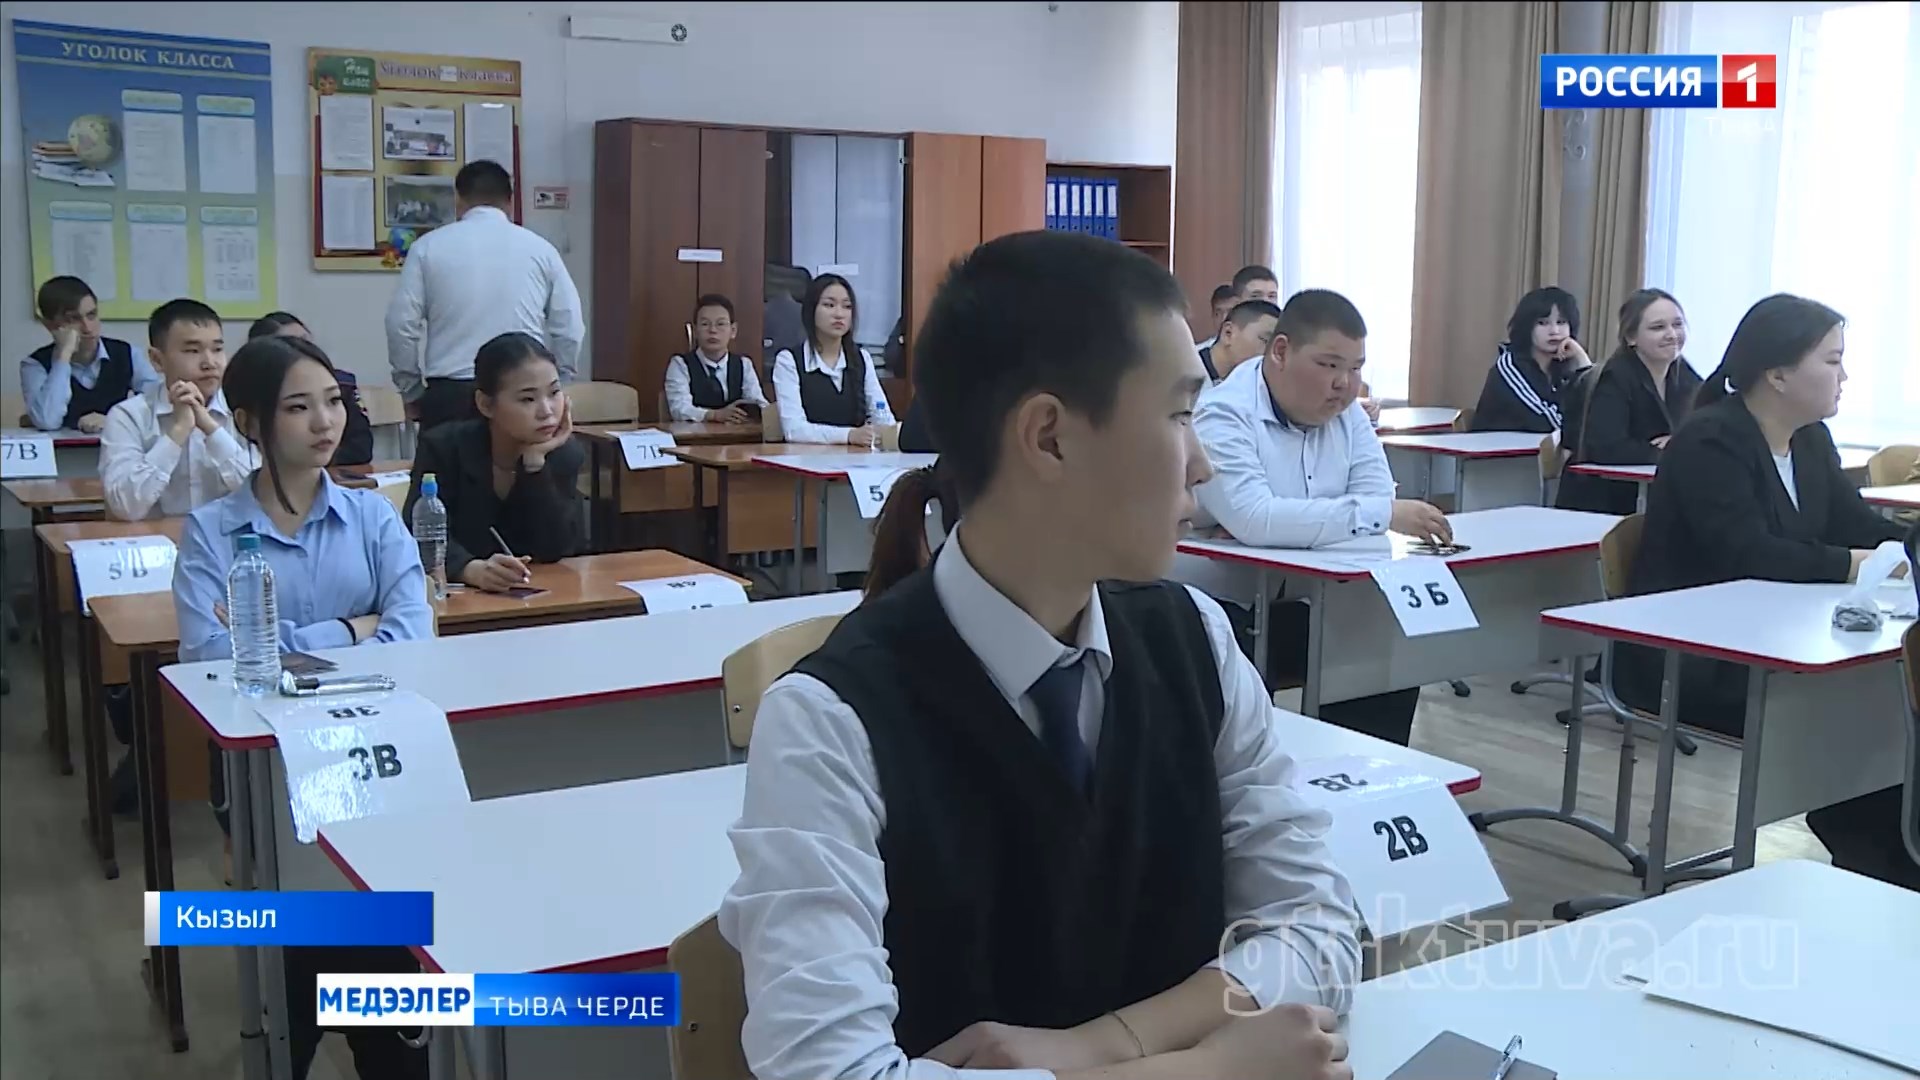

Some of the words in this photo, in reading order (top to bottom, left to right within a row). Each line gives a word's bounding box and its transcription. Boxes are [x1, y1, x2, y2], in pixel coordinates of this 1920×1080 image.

[61, 41, 147, 64] УГОЛОК
[157, 51, 235, 69] КЛАССА
[1, 443, 38, 460] 7В
[868, 485, 884, 502] 5
[347, 743, 402, 781] 3В
[1373, 814, 1429, 862] 2В
